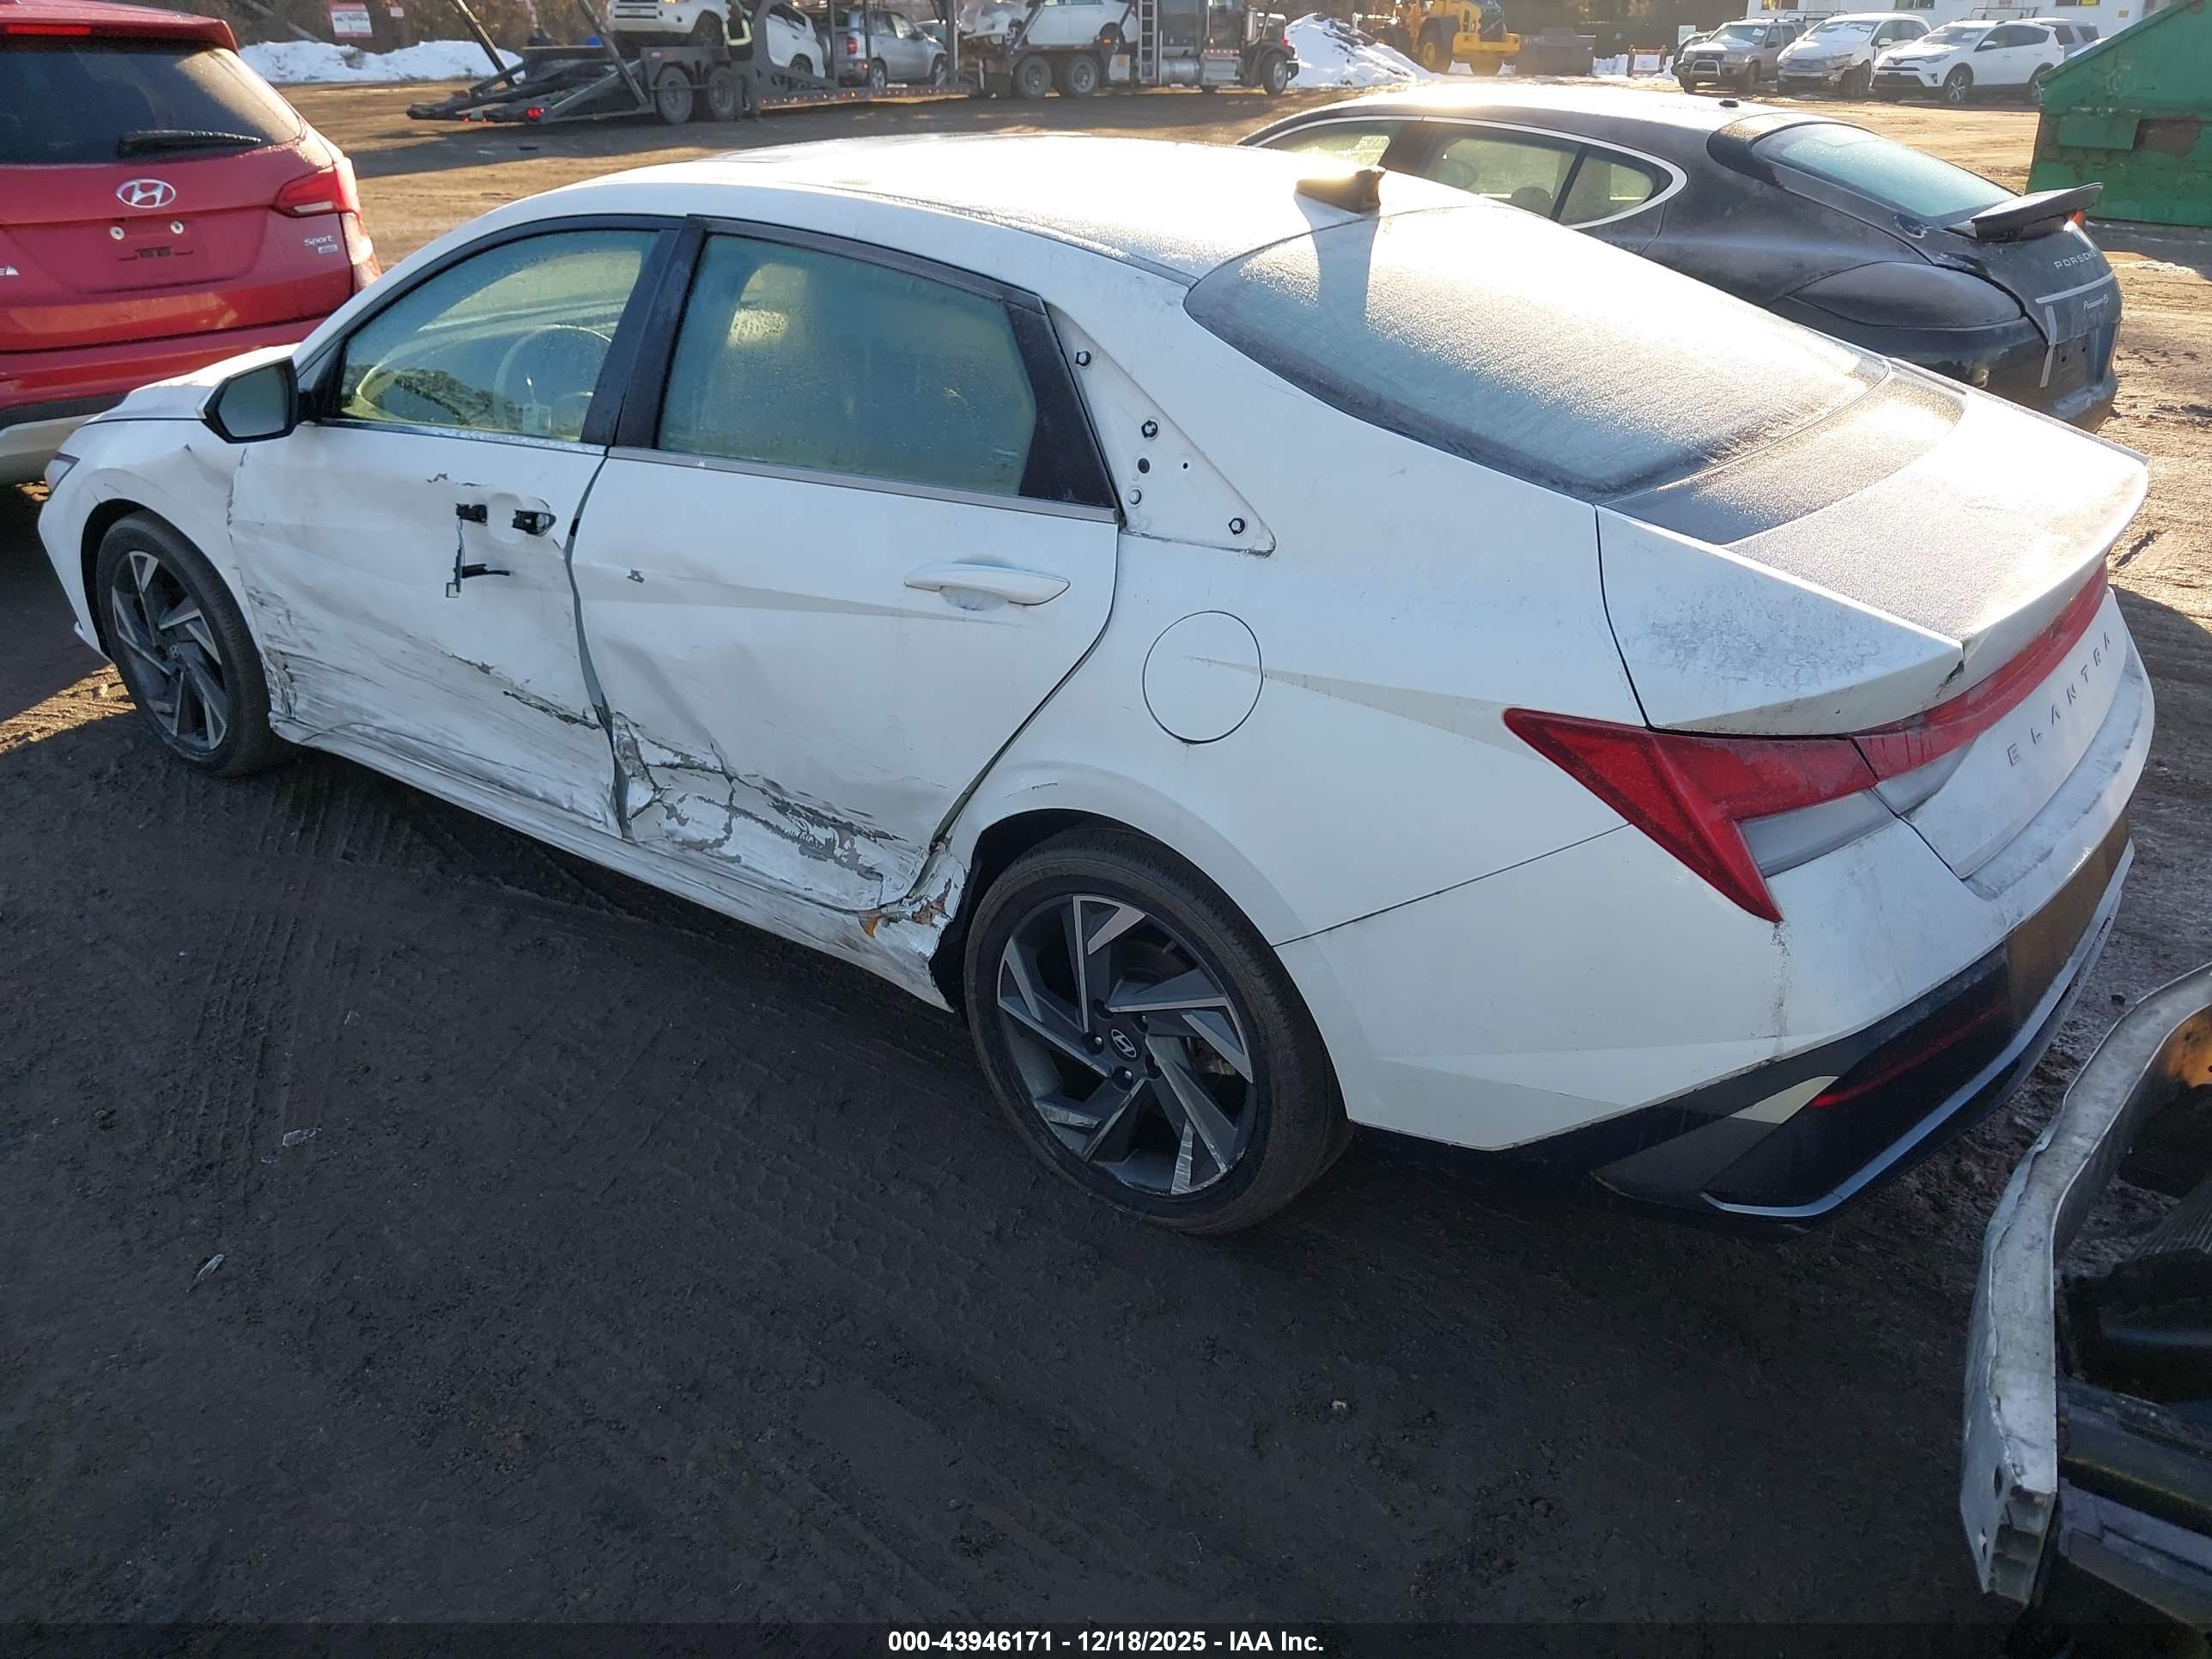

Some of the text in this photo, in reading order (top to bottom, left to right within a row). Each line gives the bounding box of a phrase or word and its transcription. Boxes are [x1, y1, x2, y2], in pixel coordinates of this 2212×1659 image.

[303, 235, 333, 246] Sport
[2053, 249, 2097, 269] PORSCHE
[2007, 631, 2111, 767] ELANTRA
